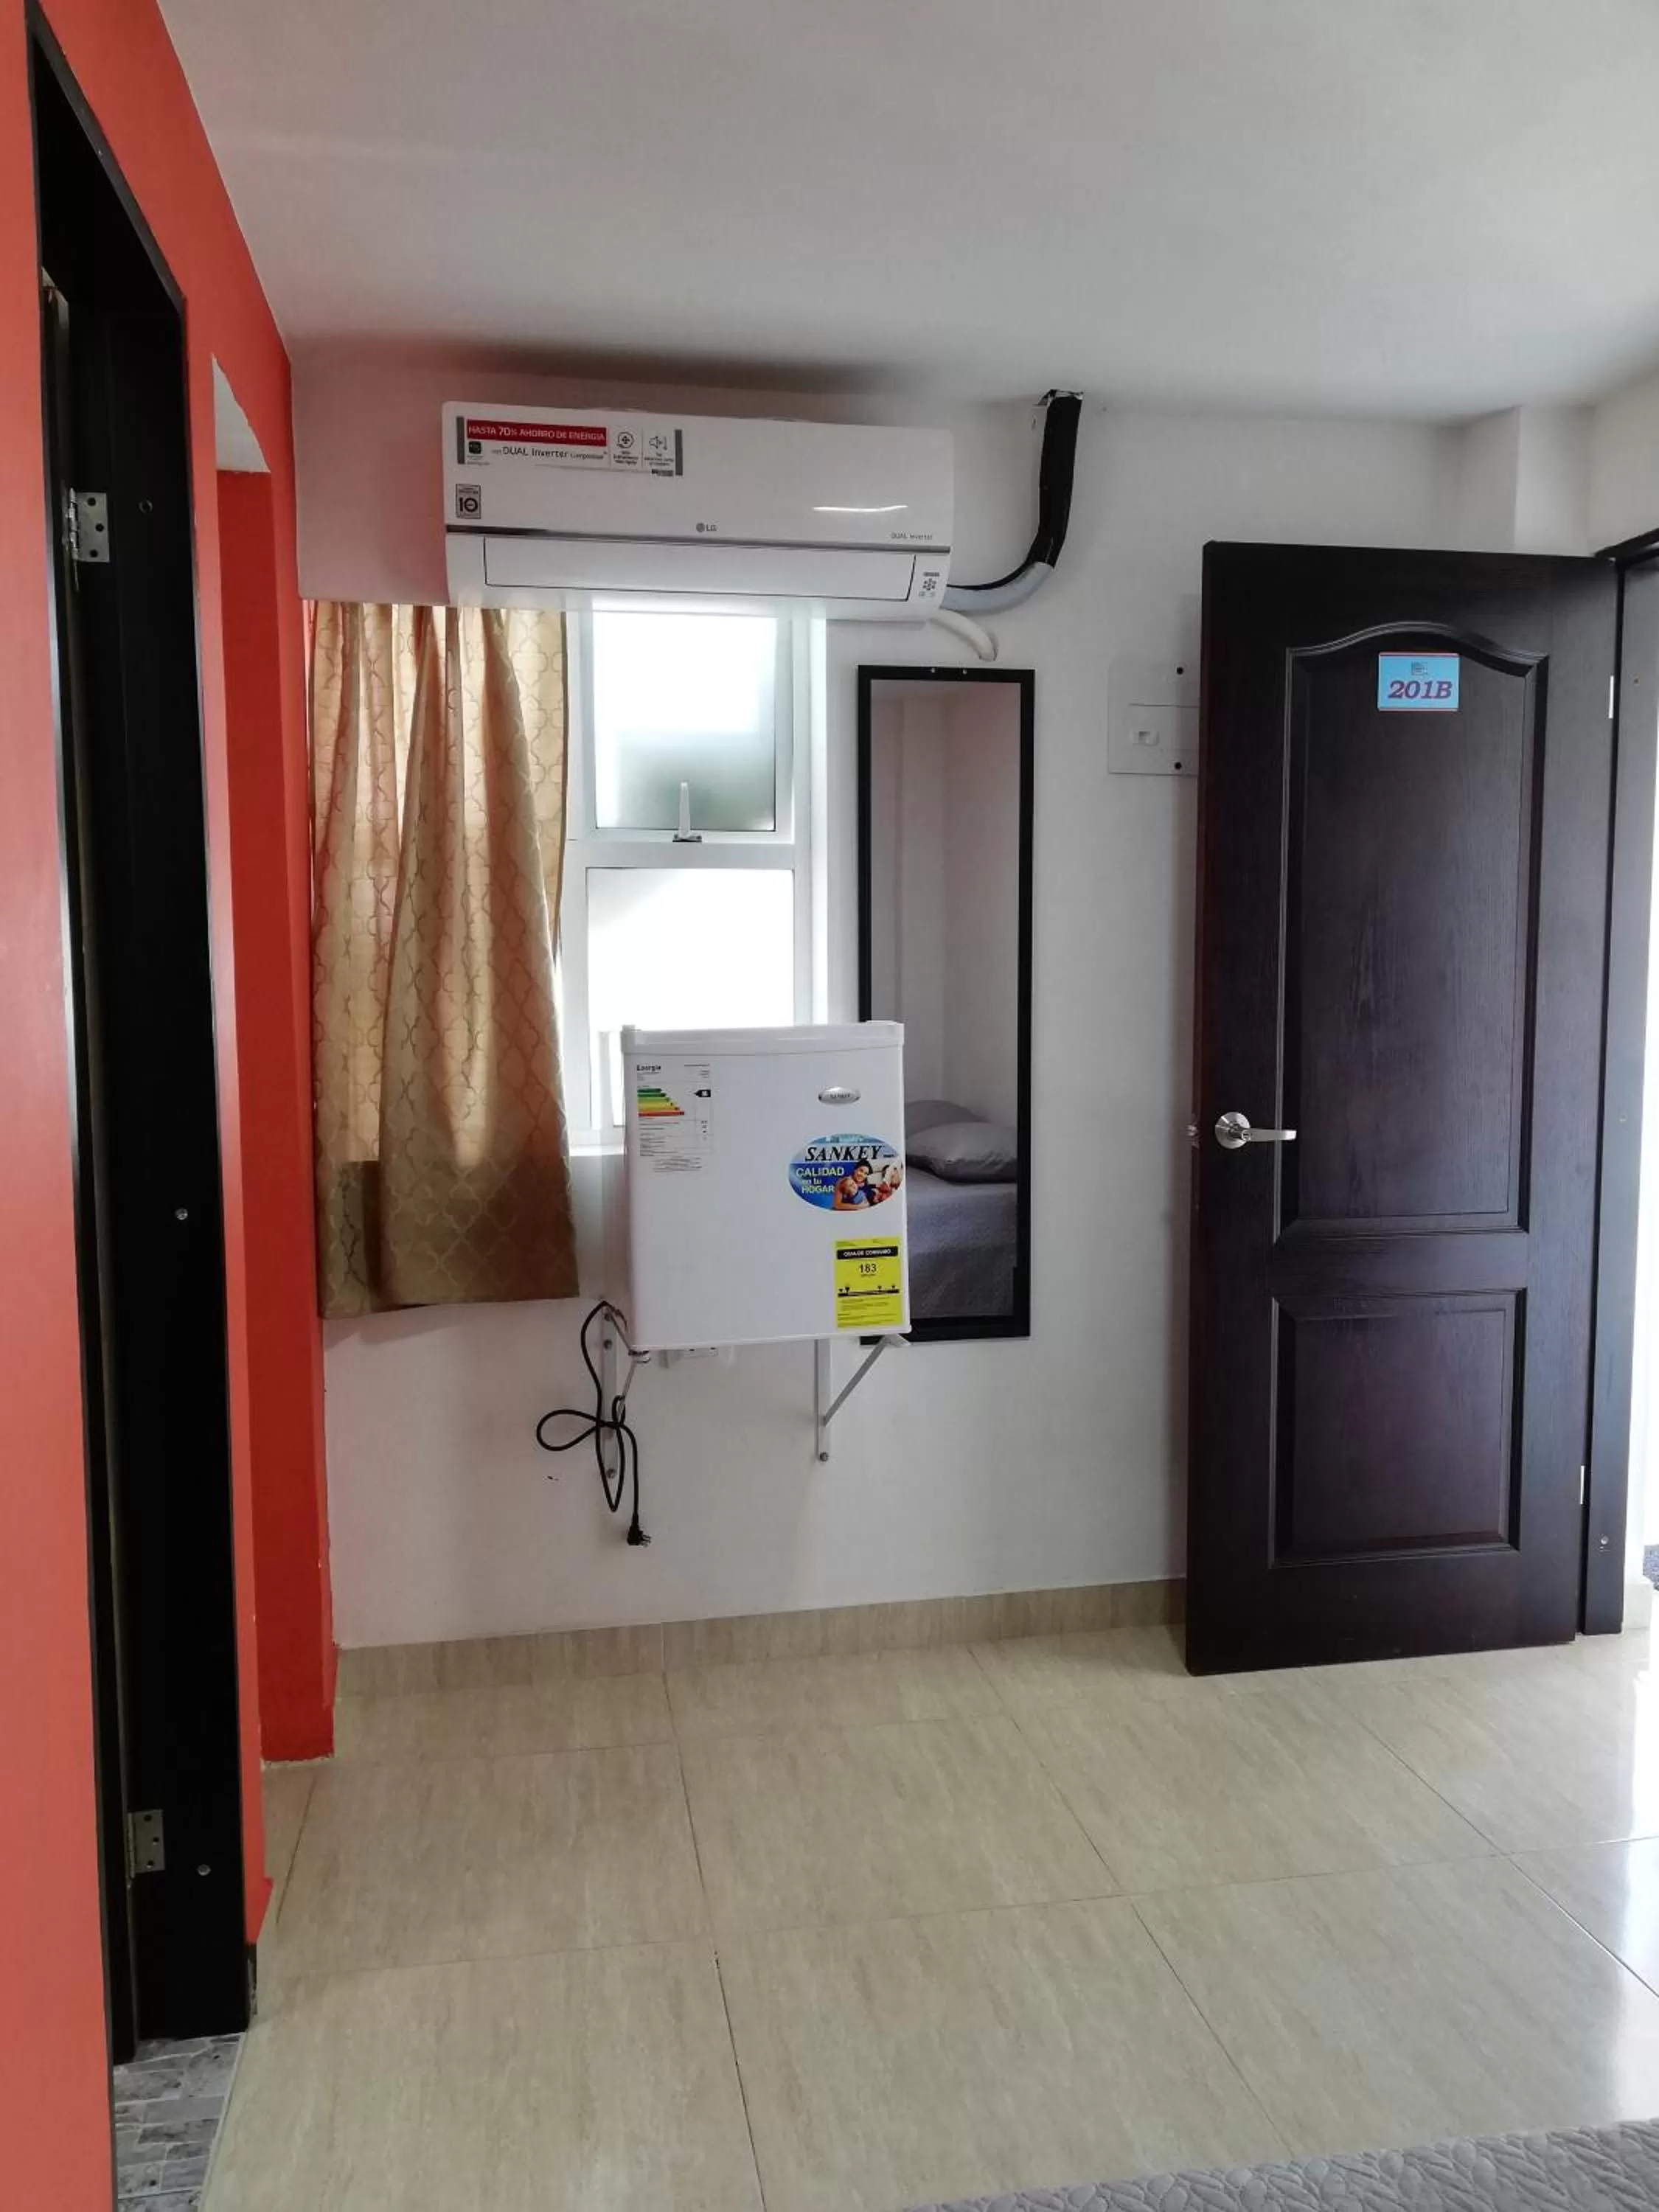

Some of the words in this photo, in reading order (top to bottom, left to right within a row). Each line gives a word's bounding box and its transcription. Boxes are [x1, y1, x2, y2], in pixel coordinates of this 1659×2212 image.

[468, 425, 496, 434] HASTA
[498, 427, 517, 437] 70%
[519, 429, 554, 439] AHORRO
[503, 446, 529, 456] DUAL
[532, 448, 568, 458] Inverter
[706, 524, 717, 532] LG
[1388, 680, 1453, 700] 201B
[805, 1145, 882, 1162] SANKEY
[796, 1166, 844, 1178] CALIDAD
[801, 1185, 835, 1194] HOGAR
[860, 1263, 877, 1273] 183
